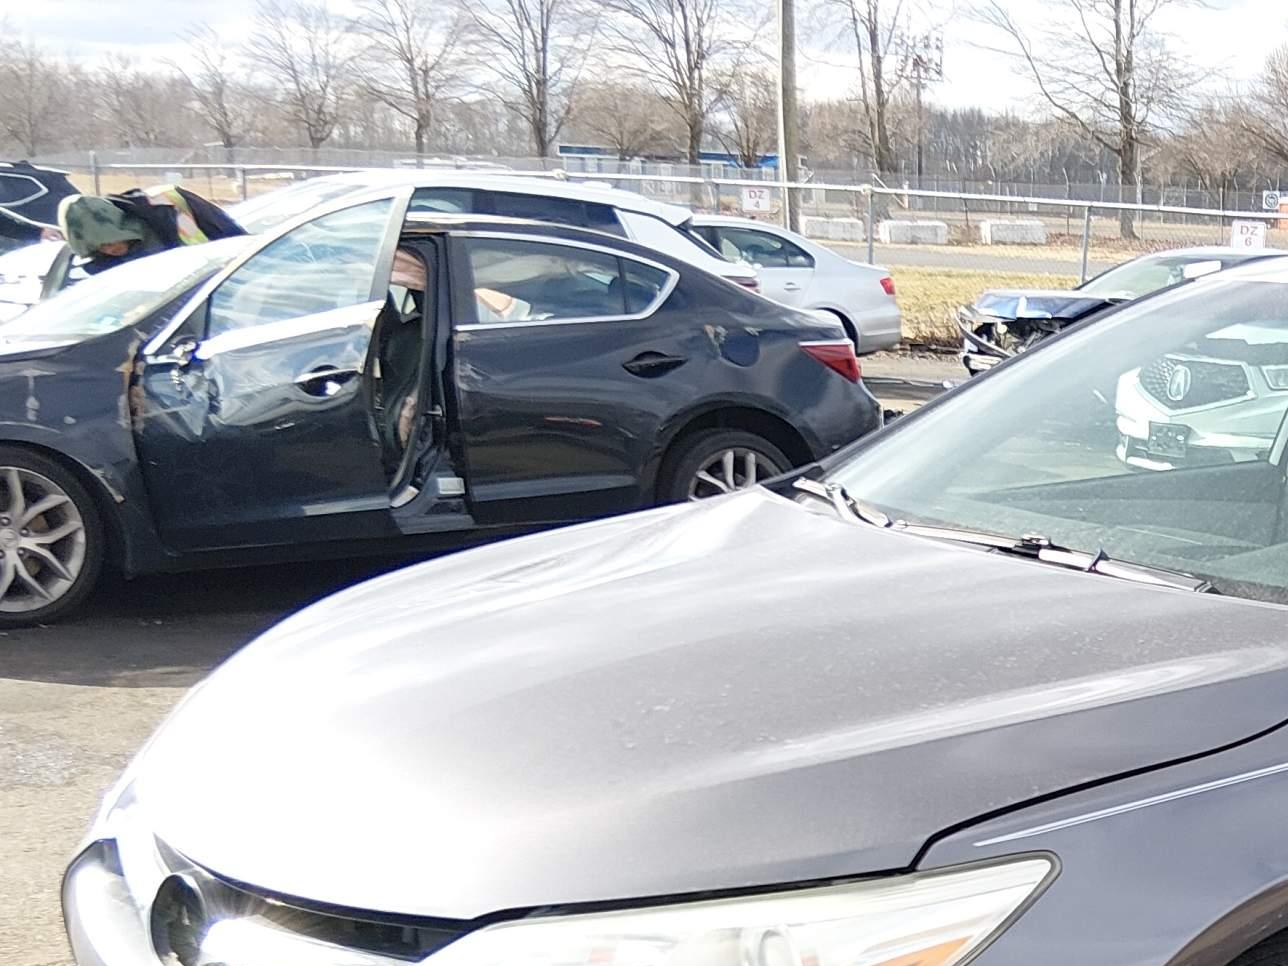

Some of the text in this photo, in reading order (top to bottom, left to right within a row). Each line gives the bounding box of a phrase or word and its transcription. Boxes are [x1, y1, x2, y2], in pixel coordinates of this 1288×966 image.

[748, 190, 766, 199] DZ
[1240, 225, 1258, 236] DZ
[1244, 237, 1252, 246] 6
